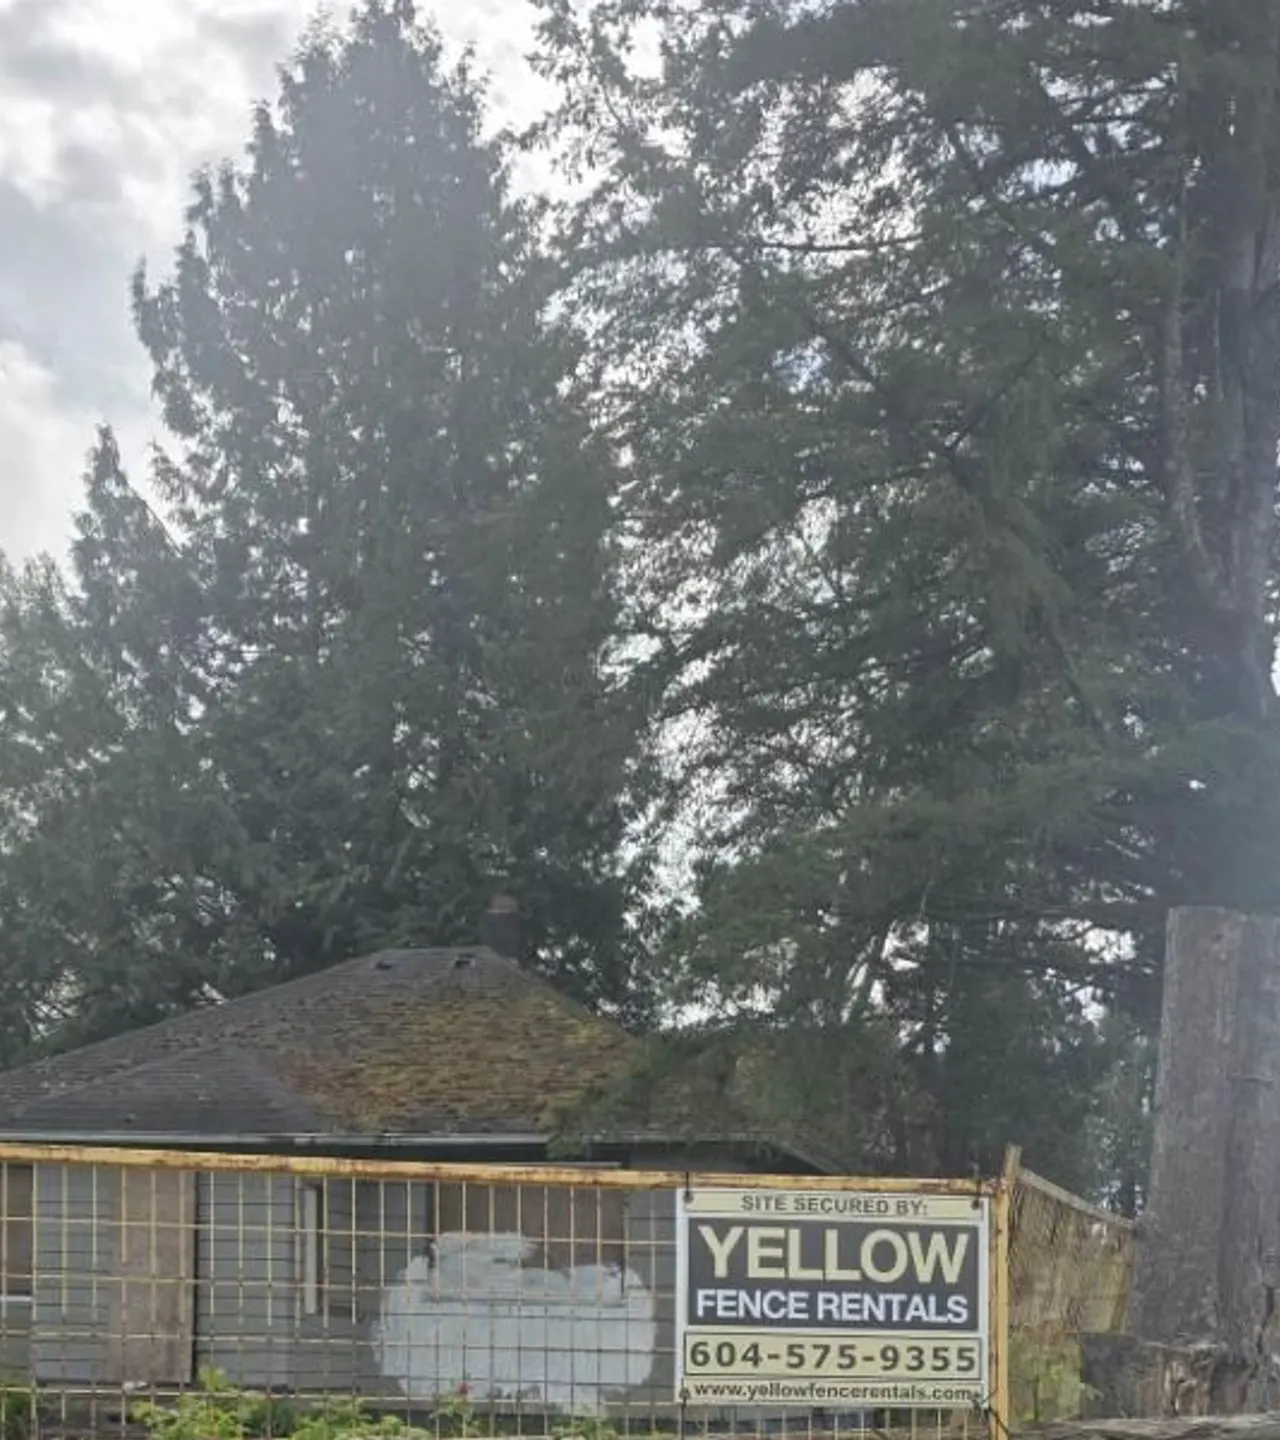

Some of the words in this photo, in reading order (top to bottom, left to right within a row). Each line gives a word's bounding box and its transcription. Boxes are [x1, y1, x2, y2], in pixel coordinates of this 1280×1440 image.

[740, 1195, 788, 1212] SITE
[794, 1197, 889, 1215] SECURED
[896, 1199, 928, 1216] BY:
[697, 1225, 969, 1284] YELLOW
[697, 1288, 809, 1319] FENCE
[817, 1292, 969, 1324] RENTALS
[689, 1341, 977, 1373] 604-575-9355
[694, 1380, 972, 1401] www.yellowfencerentals.com
